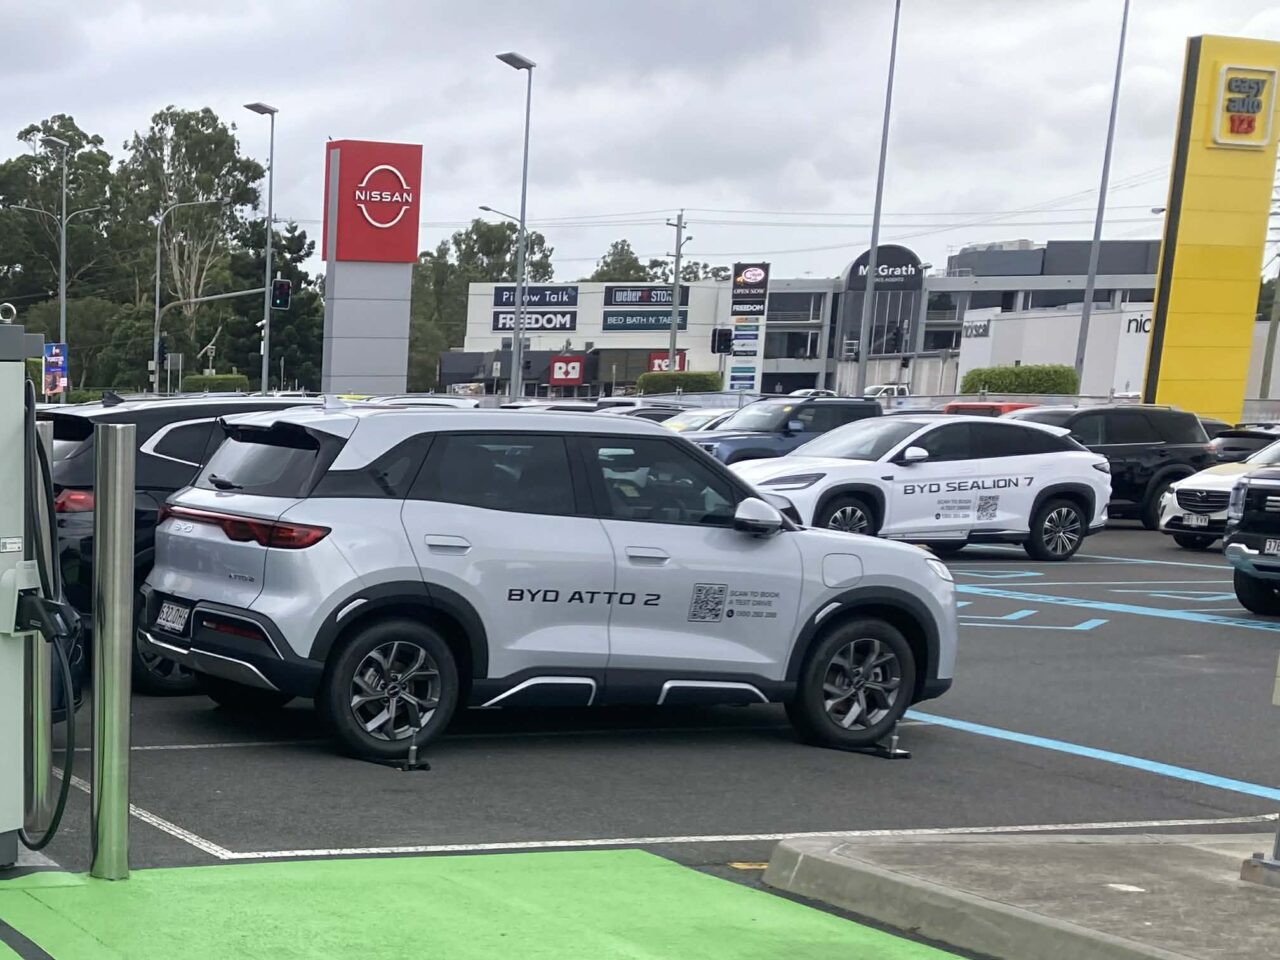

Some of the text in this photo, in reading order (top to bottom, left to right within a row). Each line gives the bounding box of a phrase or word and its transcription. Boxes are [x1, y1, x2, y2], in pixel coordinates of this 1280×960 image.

[1228, 77, 1266, 97] easy
[1227, 97, 1262, 113] auto
[1230, 114, 1256, 134] 123
[355, 190, 412, 202] NISSAN
[859, 264, 915, 276] MGrath
[502, 291, 569, 302] Piow Talk
[615, 289, 676, 302] weber STOR
[607, 316, 629, 324] BED
[631, 316, 651, 324] BATH
[664, 316, 683, 324] TABE
[903, 477, 1034, 495] BYD SEALION 7
[507, 588, 661, 607] BYD ATTO 2
